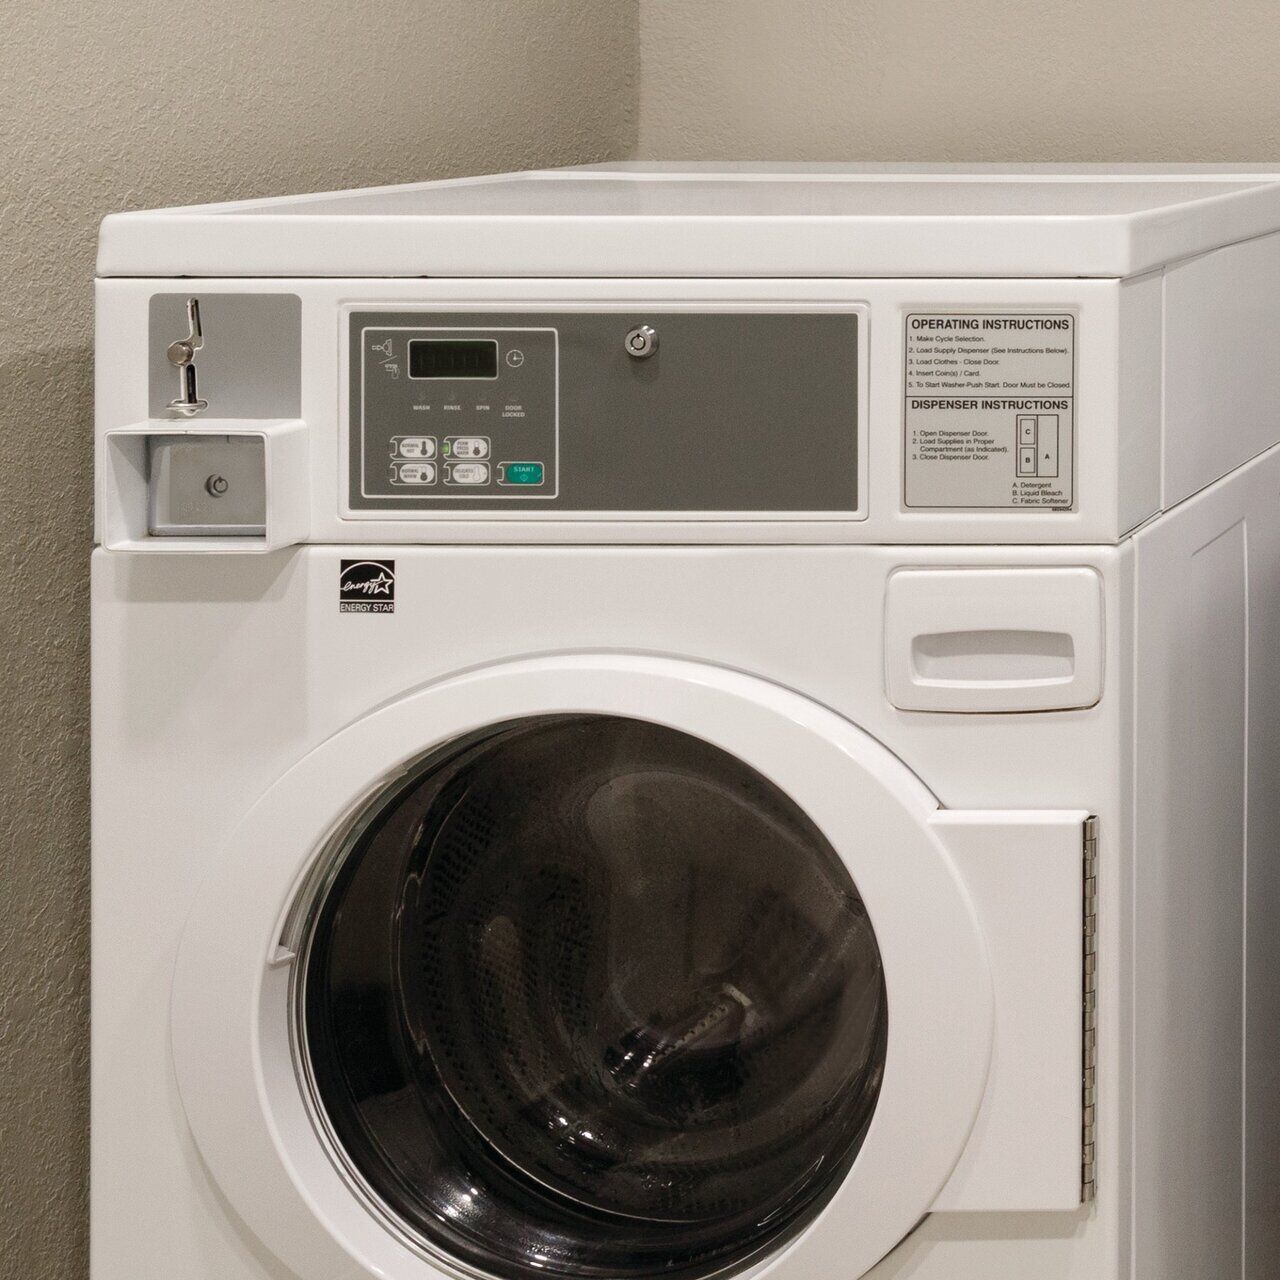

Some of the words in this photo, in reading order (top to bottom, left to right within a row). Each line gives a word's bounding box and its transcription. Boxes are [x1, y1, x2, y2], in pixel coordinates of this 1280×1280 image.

[912, 319, 979, 330] OPERATING
[982, 319, 1069, 330] INSTRUCTIONS
[912, 400, 978, 410] DISPENSER
[981, 400, 1068, 410] INSTRUCTIONS
[920, 430, 937, 438] Open
[939, 430, 971, 438] Dispenser
[340, 603, 371, 612] ENERGY
[373, 603, 393, 612] STAR
